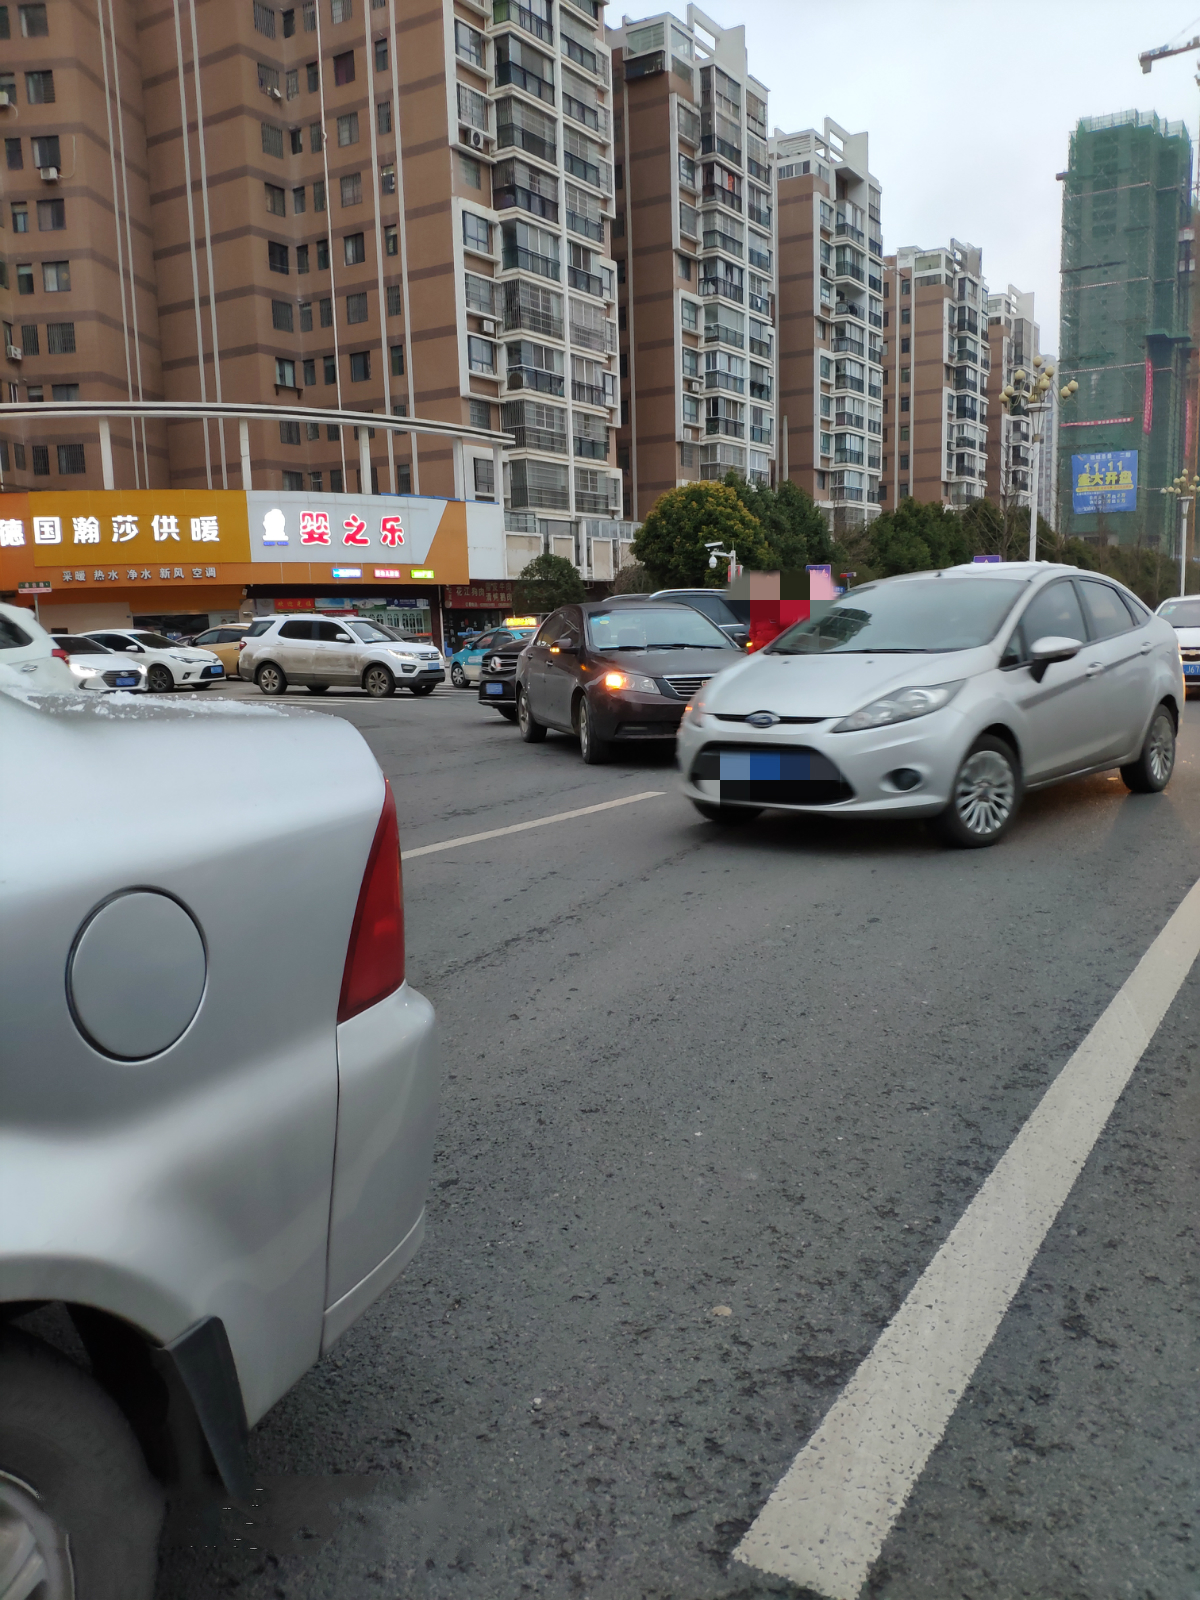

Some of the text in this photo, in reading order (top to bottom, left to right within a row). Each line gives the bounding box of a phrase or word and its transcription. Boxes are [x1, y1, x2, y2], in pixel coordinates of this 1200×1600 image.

[1084, 461, 1123, 472] 11.11
[1078, 470, 1133, 487] 盛大开盘
[0, 515, 220, 547] 德国瀚莎供暖
[299, 510, 405, 547] 婴之乐
[62, 566, 217, 582] 采暖 热水 净水 新风 空调
